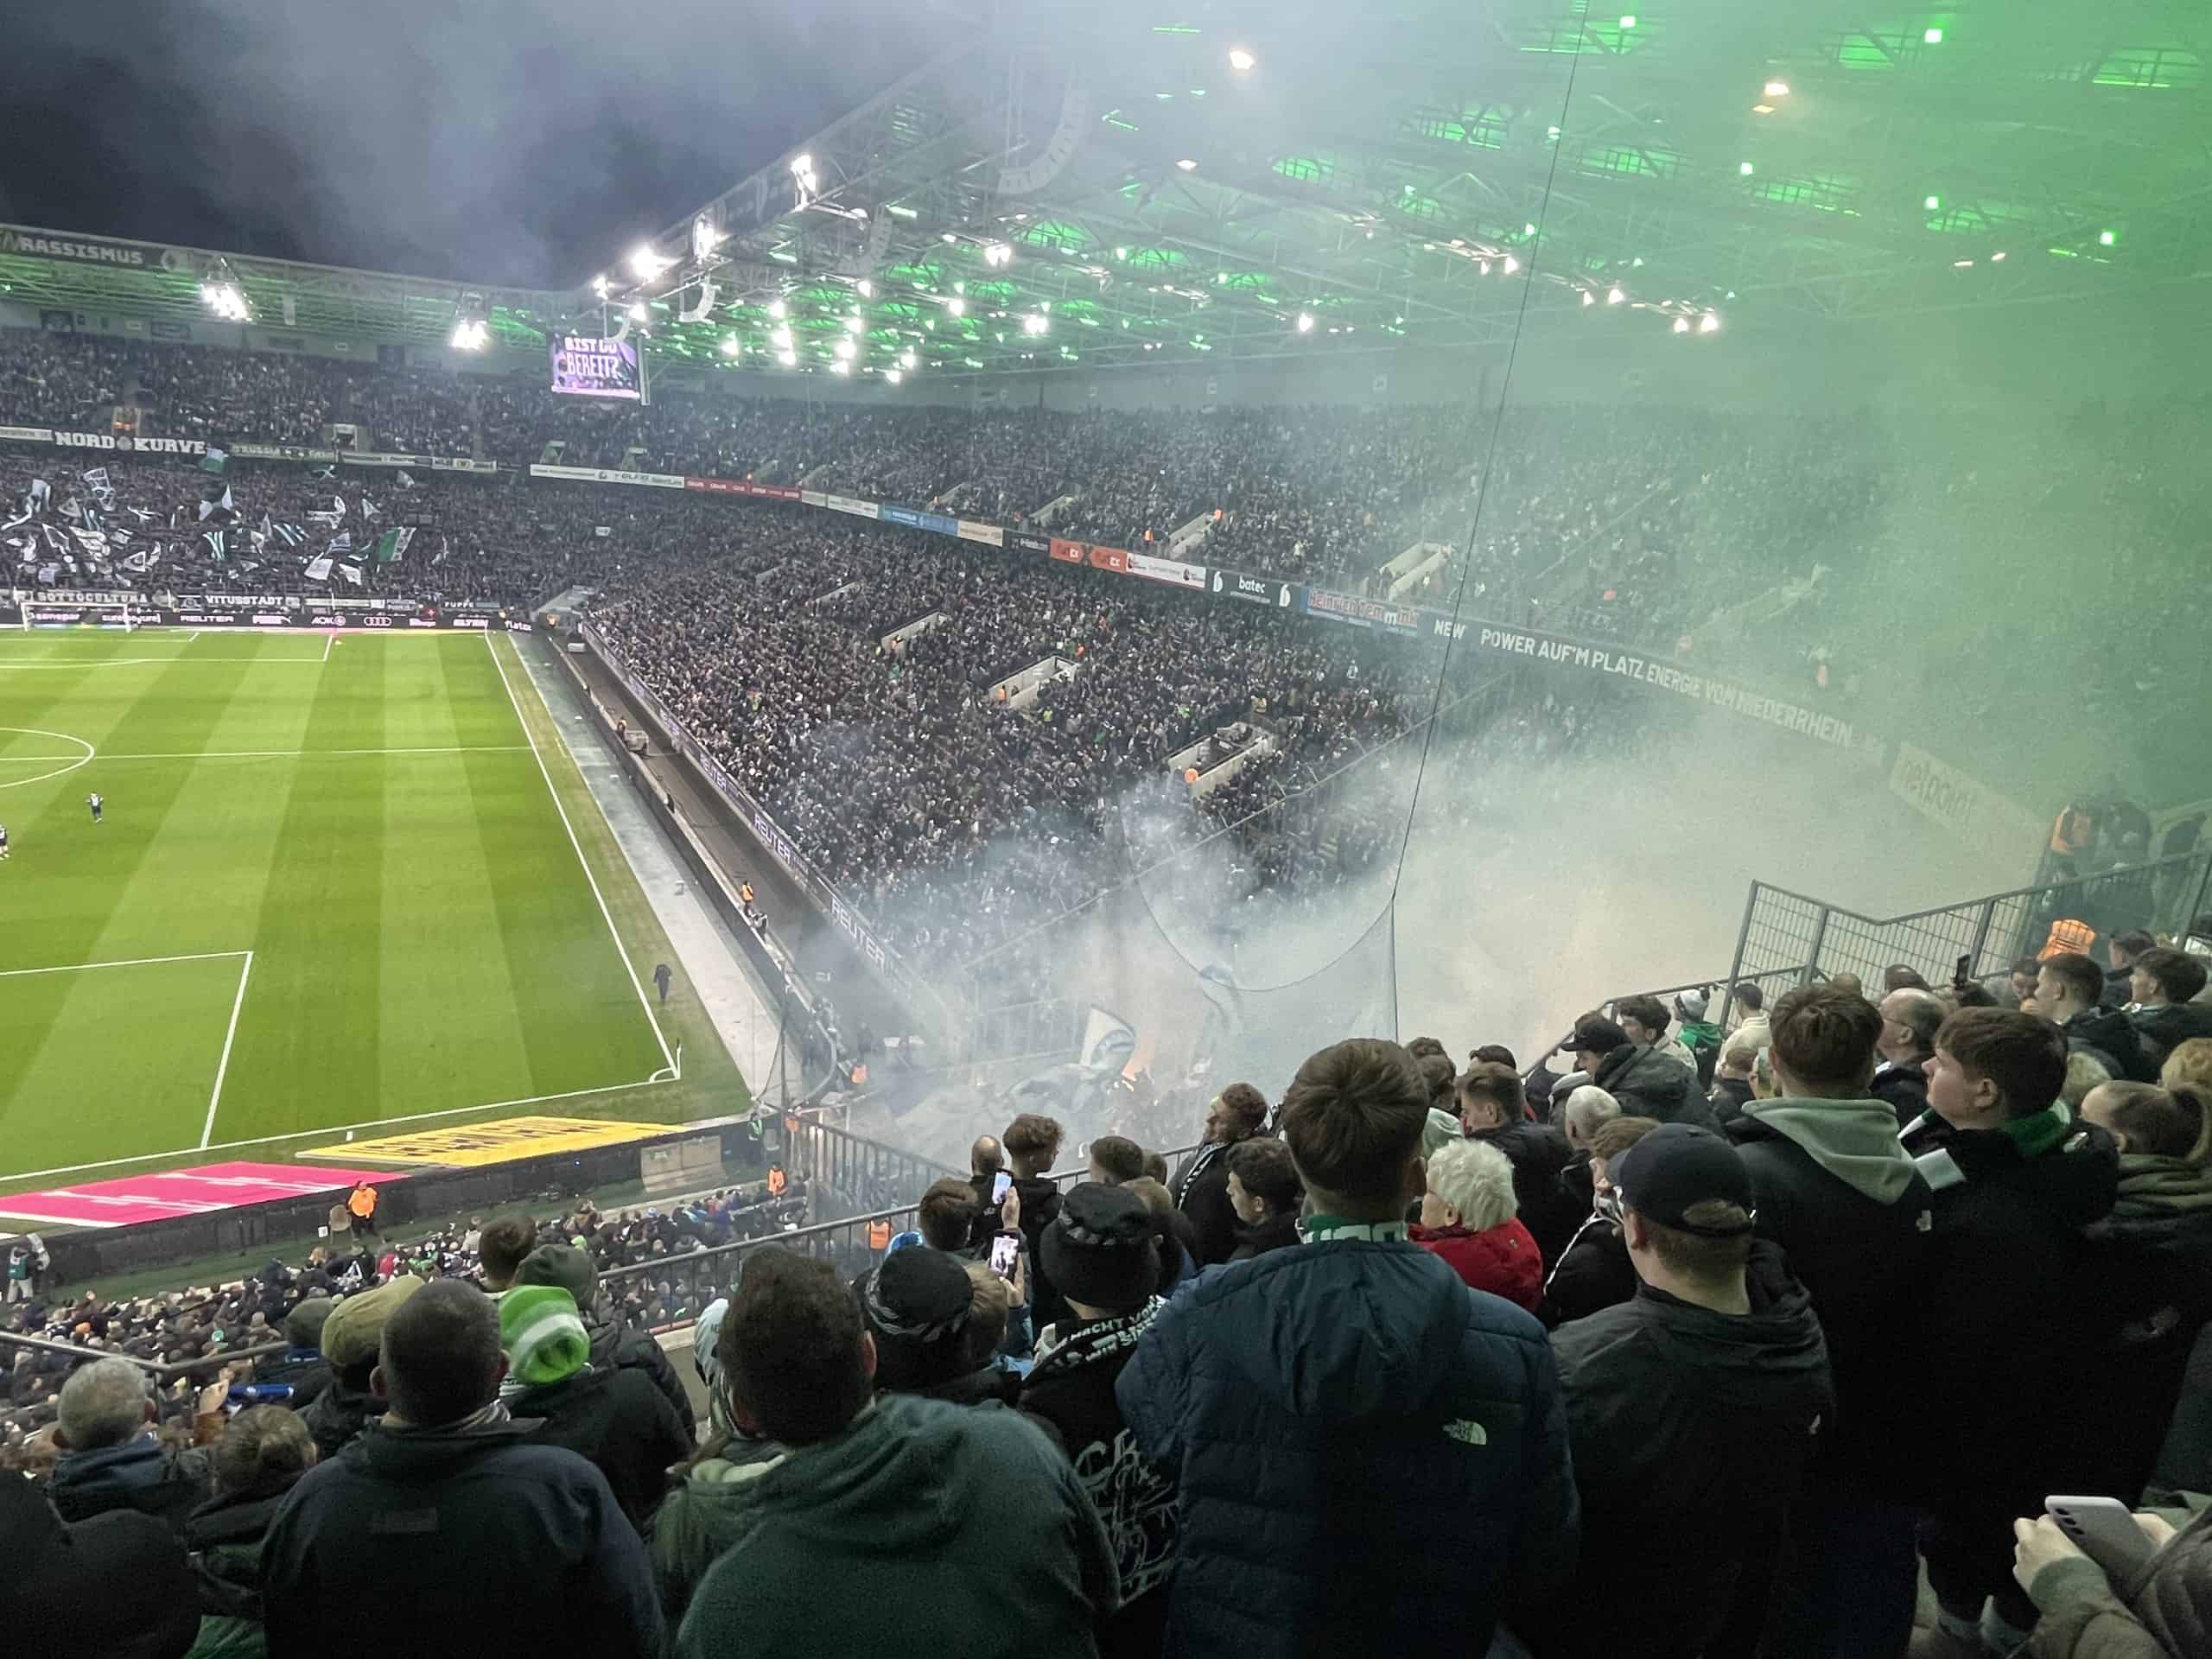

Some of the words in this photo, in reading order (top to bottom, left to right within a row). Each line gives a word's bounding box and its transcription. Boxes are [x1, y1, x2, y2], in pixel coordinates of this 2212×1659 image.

[18, 235, 144, 265] RASSISMUS
[54, 431, 116, 450] NORD
[133, 436, 207, 455] KURVE
[1433, 619, 1466, 640] NEW
[1480, 628, 1536, 656] POWER
[1591, 650, 1645, 680] PLATZ
[754, 813, 791, 866] REUTER
[831, 896, 886, 970] REUTER
